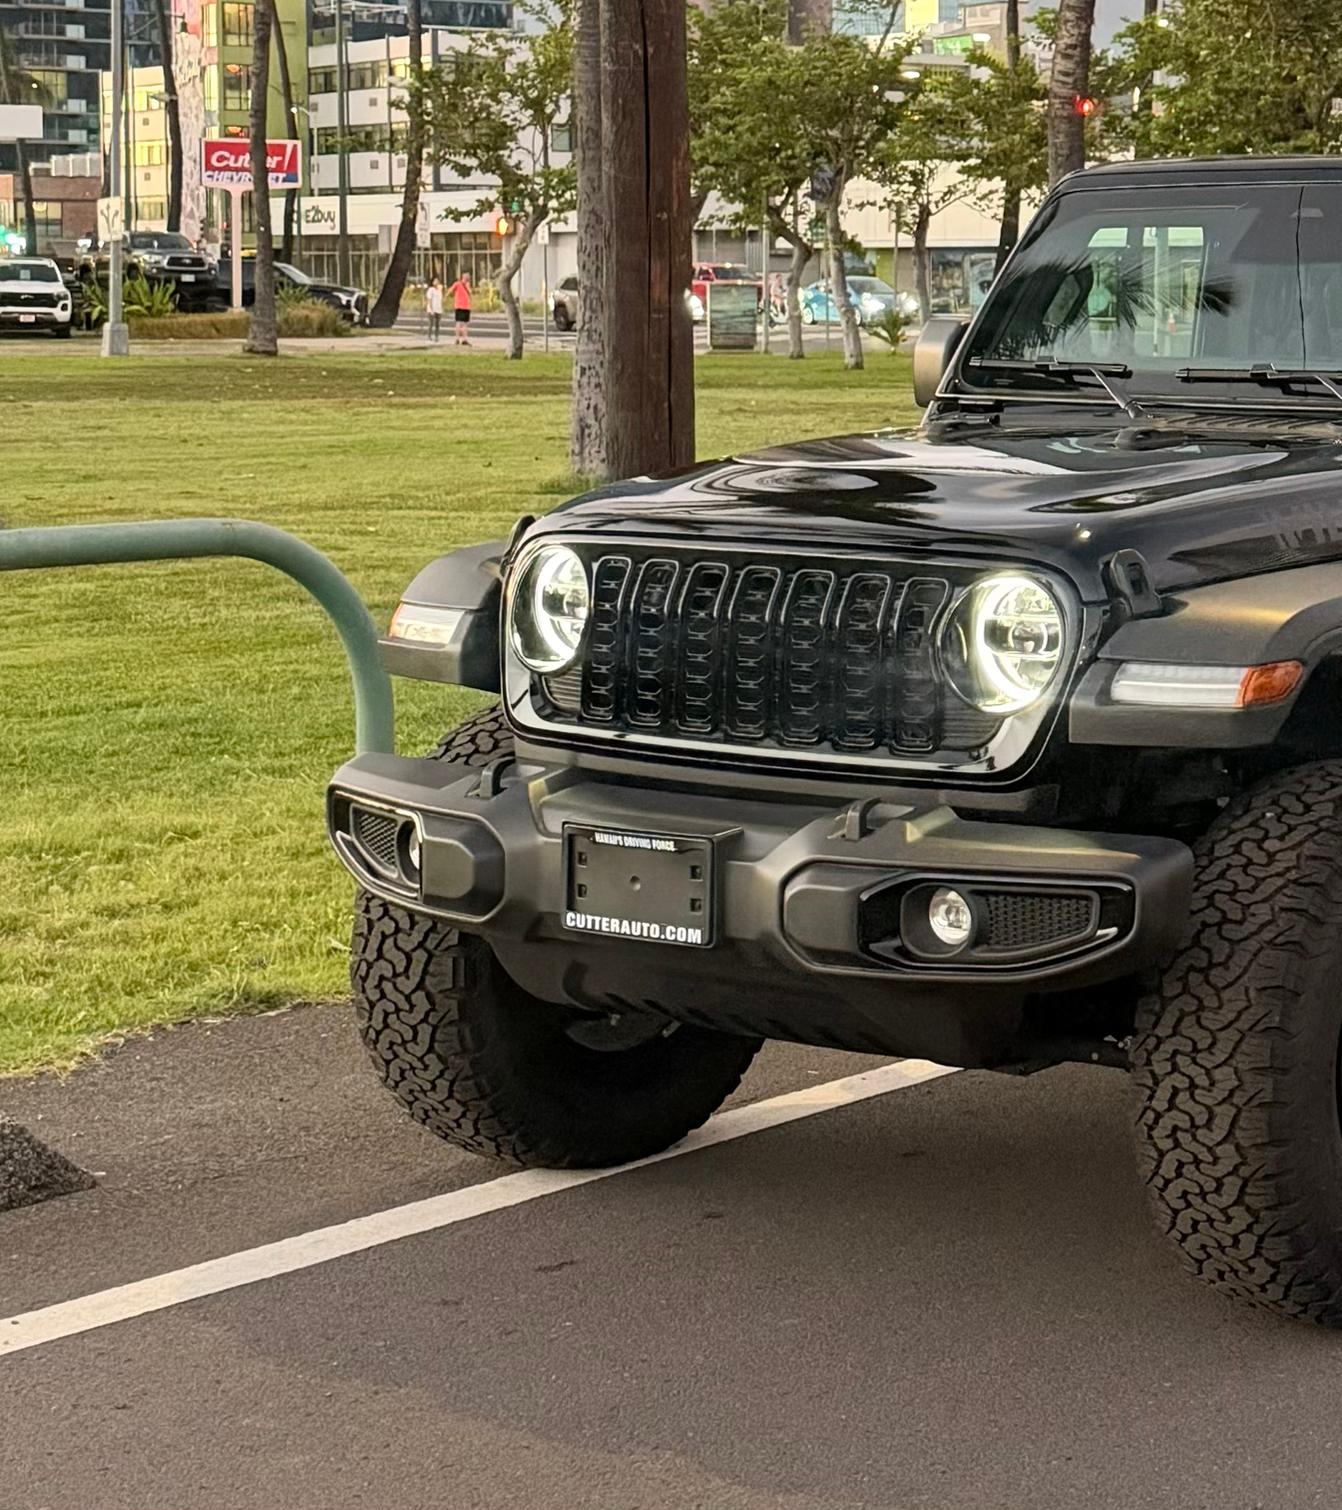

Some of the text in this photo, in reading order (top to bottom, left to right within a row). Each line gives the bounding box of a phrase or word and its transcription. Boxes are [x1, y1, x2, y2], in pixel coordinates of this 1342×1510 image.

[210, 151, 283, 168] Cuter
[205, 171, 287, 183] CHEVRET
[623, 835, 652, 850] DRIVING
[565, 911, 702, 945] CUTTERAUTO.COM
